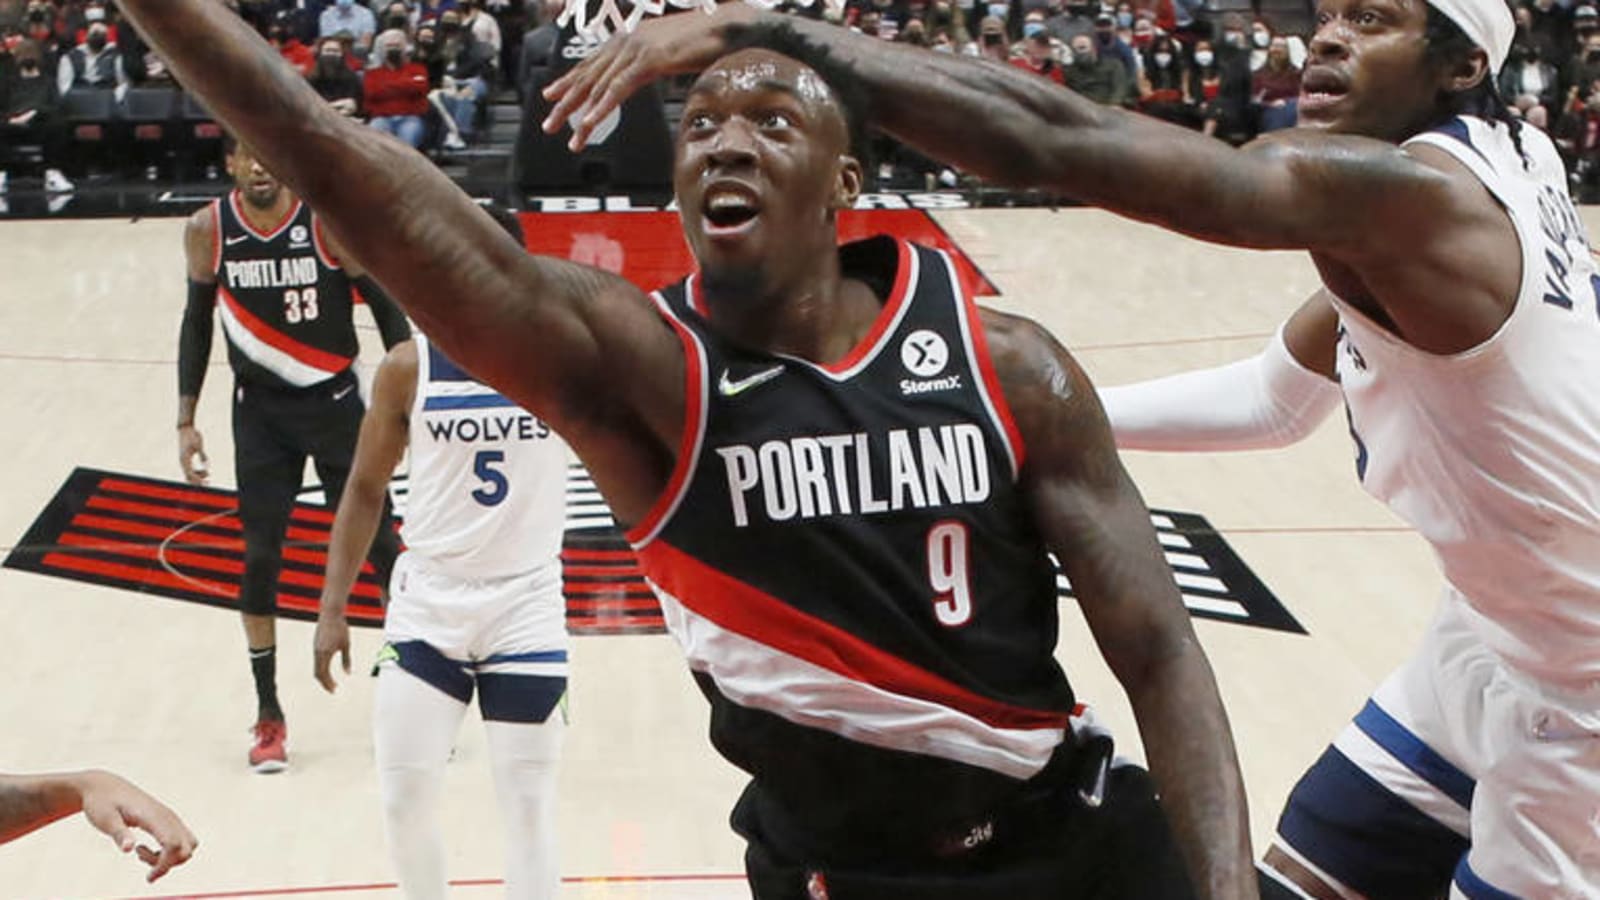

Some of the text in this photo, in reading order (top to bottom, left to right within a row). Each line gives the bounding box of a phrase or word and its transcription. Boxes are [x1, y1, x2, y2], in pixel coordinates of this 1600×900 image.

[224, 256, 318, 288] PORTLAND
[284, 287, 318, 324] 33
[900, 375, 962, 396] StormX
[426, 416, 550, 442] WOLVES
[471, 450, 509, 507] 5
[715, 423, 991, 527] PORTLAND
[927, 519, 973, 627] 9
